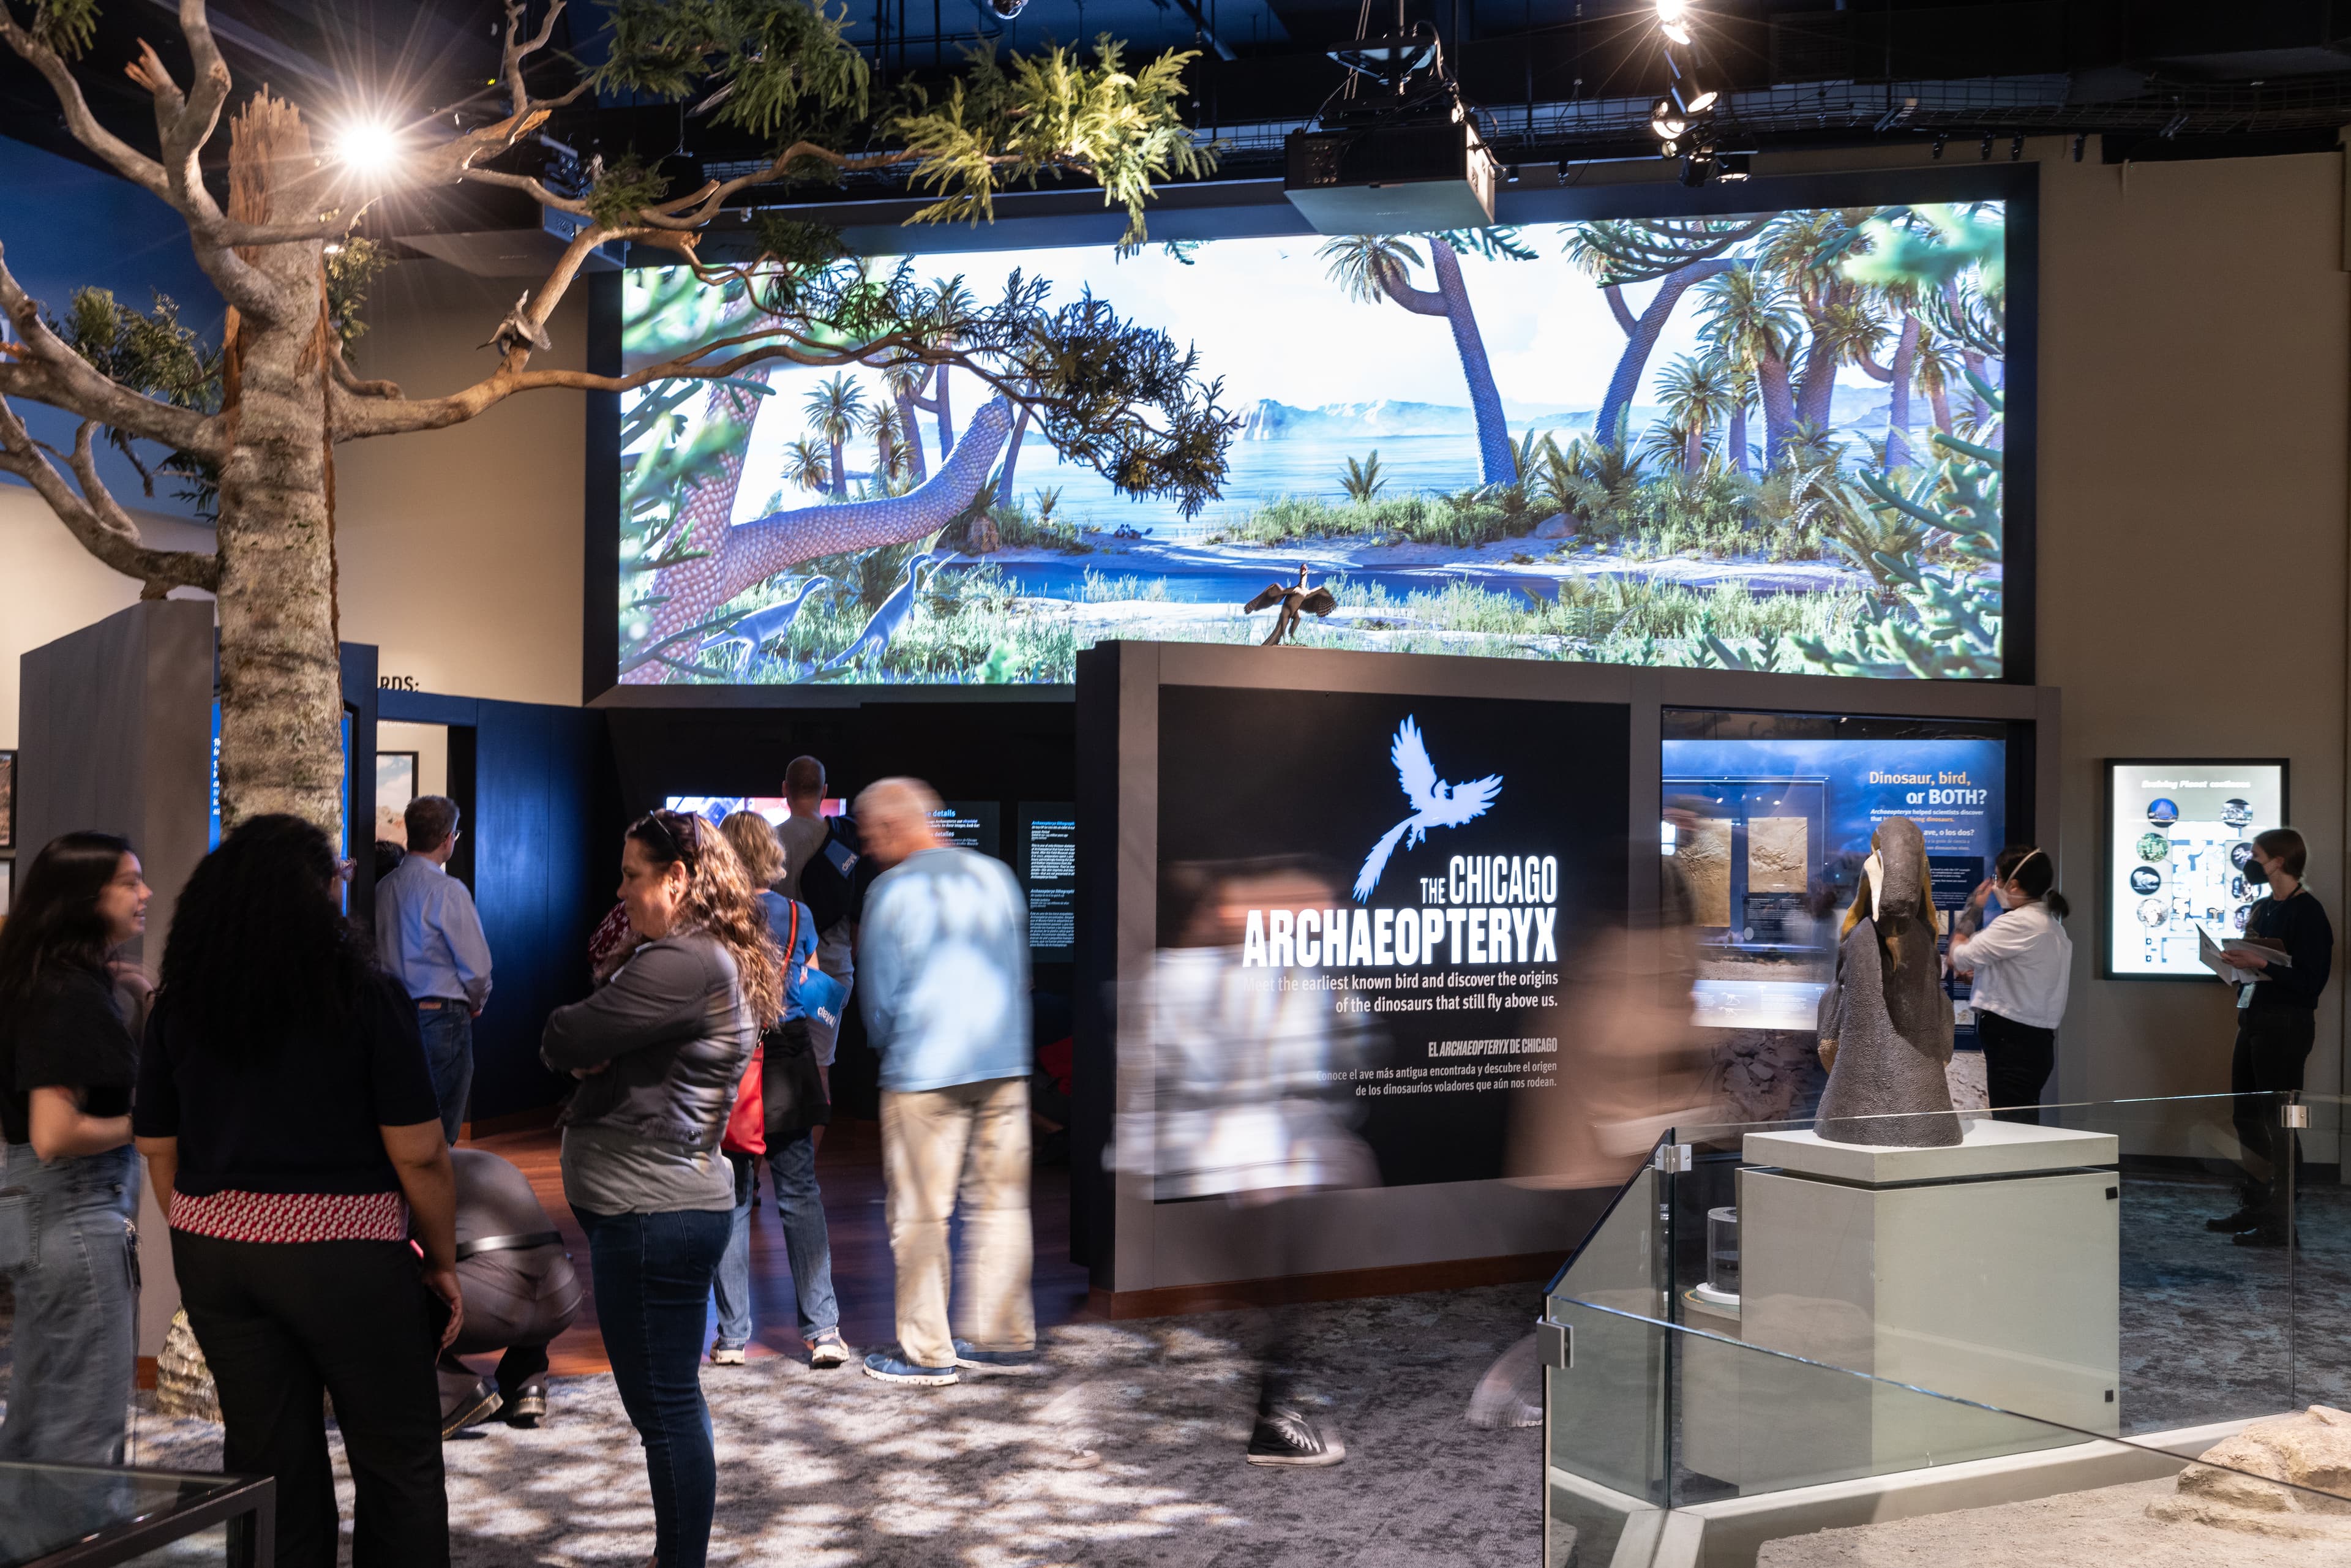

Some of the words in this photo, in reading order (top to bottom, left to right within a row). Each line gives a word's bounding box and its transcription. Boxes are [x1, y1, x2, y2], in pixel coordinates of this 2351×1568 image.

[1869, 771, 1935, 786] Dinosaur,
[1938, 771, 1971, 786] bird,
[1906, 792, 1925, 805] or
[1929, 789, 1987, 805] BOTH?
[932, 809, 956, 817] details
[1420, 878, 1445, 904] THE
[1449, 855, 1557, 904] CHICAGO
[1243, 907, 1558, 967] ARCHAEOPTERYX
[1278, 977, 1299, 991] the
[1302, 975, 1349, 991] earliest
[1352, 974, 1392, 990] known
[1395, 973, 1419, 989] bird
[1422, 972, 1444, 988] and
[1447, 971, 1495, 988] discover
[1498, 970, 1517, 986] the
[1519, 970, 1558, 988] origins
[1336, 997, 1348, 1013] of
[1351, 997, 1371, 1013] the
[1374, 996, 1433, 1013] dinosaurs
[1436, 994, 1460, 1010] that
[1463, 994, 1485, 1010] still
[1487, 992, 1502, 1012] fly
[1505, 992, 1539, 1008] above
[1542, 995, 1558, 1007] us.
[817, 1006, 837, 1029] Map
[1428, 1041, 1438, 1057] EL
[1439, 1038, 1510, 1057] ARCHAEOPTERYX
[1510, 1038, 1521, 1054] DE
[1521, 1037, 1558, 1054] CHICAGO
[1316, 1070, 1347, 1081] Conoce
[1349, 1068, 1357, 1080] el
[1359, 1071, 1374, 1079] ave
[1376, 1067, 1394, 1079] más
[1396, 1066, 1428, 1080] antigua
[1430, 1063, 1475, 1076] encontrada
[1477, 1065, 1483, 1077] y
[1484, 1062, 1521, 1074] descubre
[1523, 1061, 1531, 1072] el
[1532, 1060, 1557, 1073] origen
[1355, 1084, 1367, 1096] de
[1368, 1084, 1381, 1095] los
[1383, 1082, 1433, 1095] dinosaurios
[1434, 1080, 1474, 1093] voladores
[1476, 1082, 1491, 1093] que
[1493, 1078, 1509, 1089] aún
[1510, 1079, 1525, 1088] nos
[1527, 1076, 1558, 1088] rodean.
